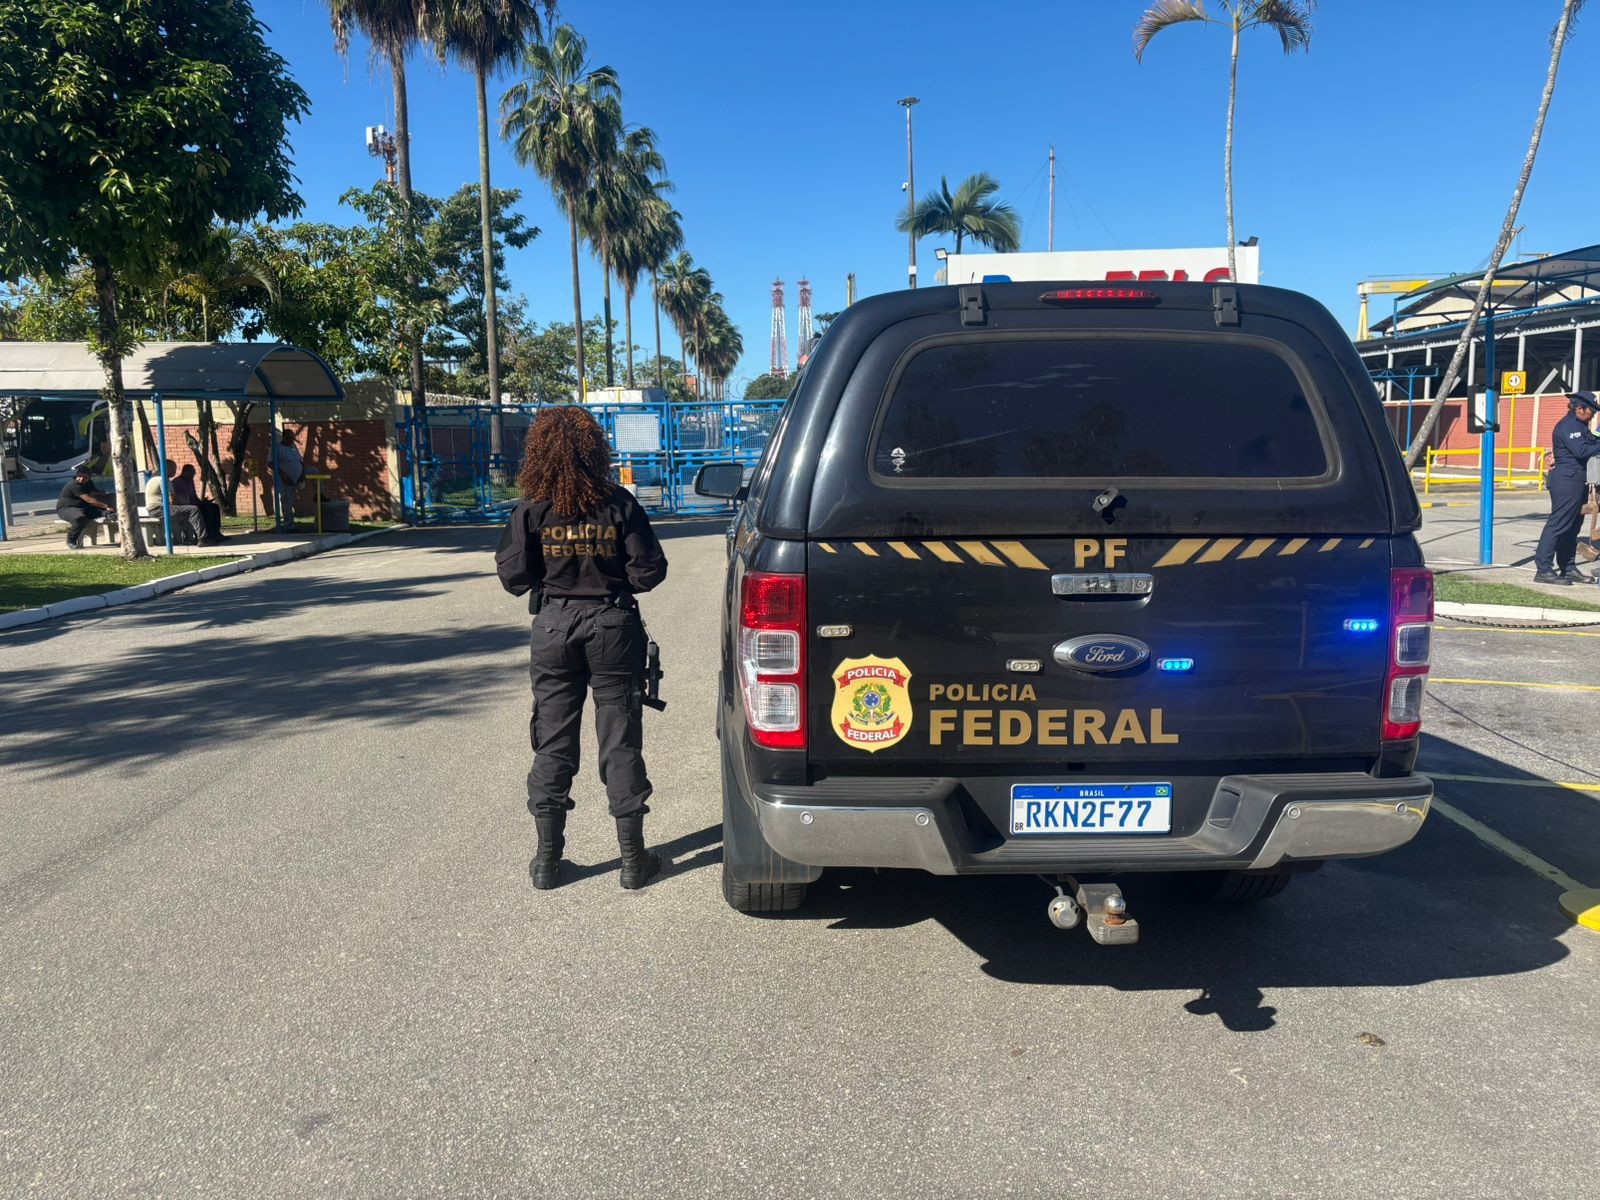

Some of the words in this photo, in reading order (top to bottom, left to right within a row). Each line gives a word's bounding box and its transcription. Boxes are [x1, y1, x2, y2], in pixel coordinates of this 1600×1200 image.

[542, 543, 617, 557] FEDERAL
[1074, 538, 1127, 569] PF
[1085, 645, 1125, 662] Ford
[929, 708, 1179, 745] FEDERAL
[847, 729, 896, 742] FEDERAL
[1079, 789, 1105, 797] BRASIL
[1026, 800, 1152, 828] RKN2F77
[1014, 822, 1024, 831] BR
